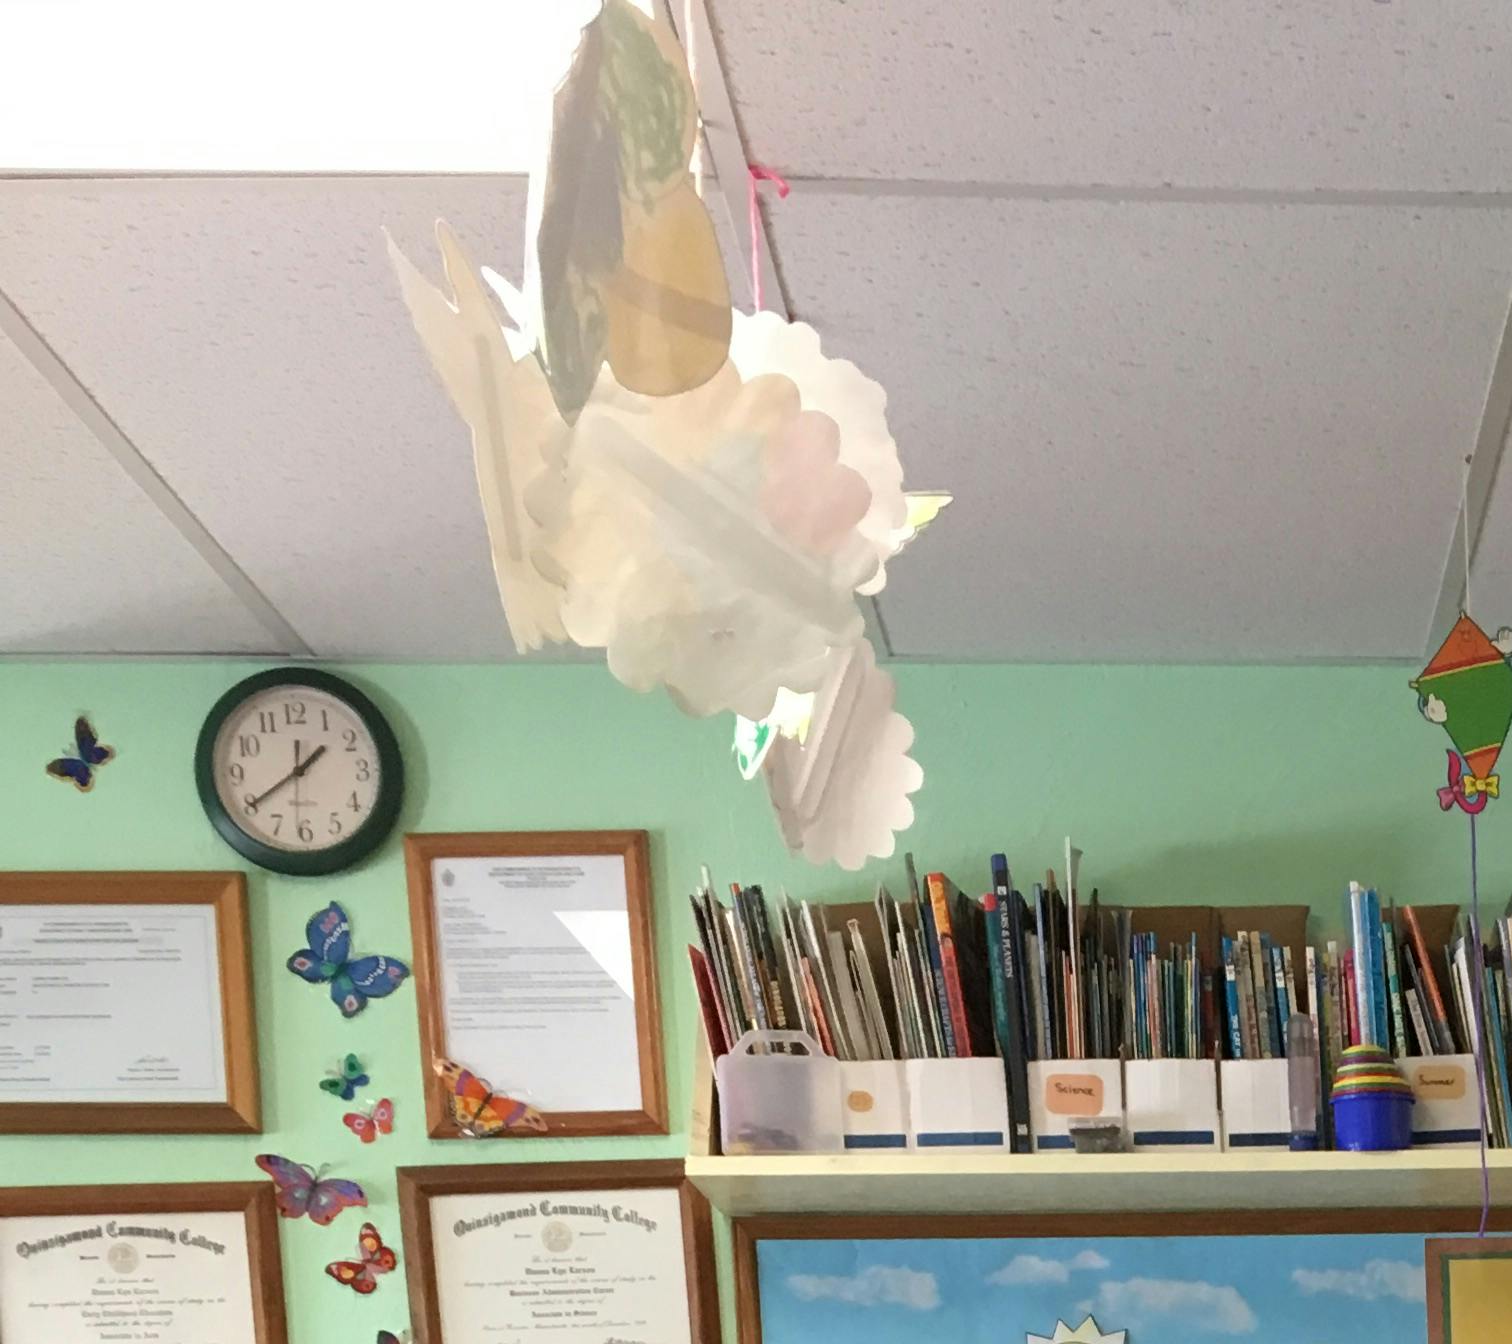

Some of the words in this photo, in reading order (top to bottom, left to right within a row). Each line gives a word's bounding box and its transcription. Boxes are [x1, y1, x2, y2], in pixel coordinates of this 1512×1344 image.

[259, 711, 277, 733] 11
[284, 701, 307, 725] 12
[321, 709, 329, 731] 1
[239, 734, 260, 757] 10
[342, 729, 357, 752] 2
[229, 763, 244, 786] 9
[355, 758, 370, 782] 3
[244, 793, 258, 817] 8
[347, 791, 361, 813] 4
[270, 813, 283, 836] 7
[298, 819, 314, 842] 6
[328, 812, 342, 835] 5
[1002, 938, 1013, 978] PLANETS
[1055, 1083, 1095, 1096] Science
[1418, 1074, 1456, 1086] Summer
[540, 1200, 610, 1222] Community
[612, 1205, 657, 1232] College
[105, 1221, 176, 1244] Community
[179, 1229, 226, 1255] College
